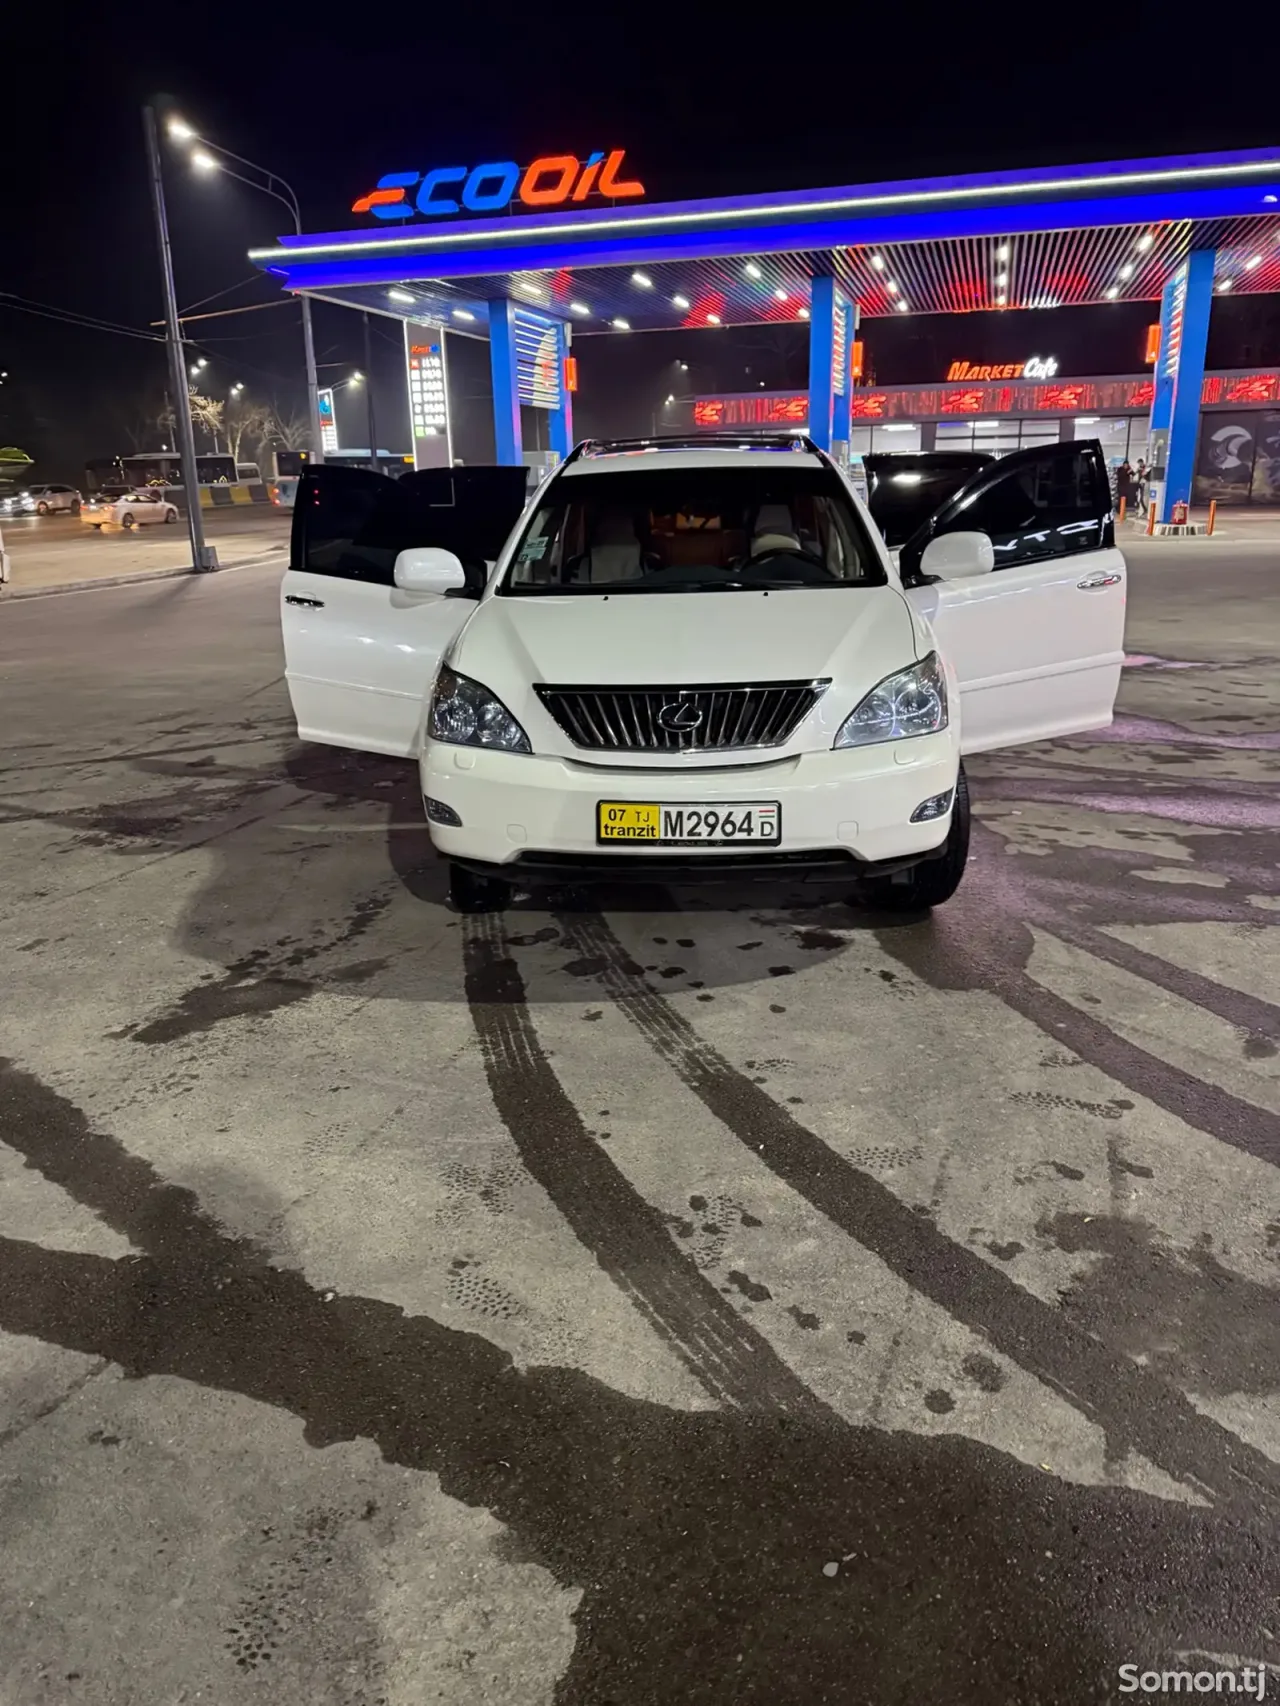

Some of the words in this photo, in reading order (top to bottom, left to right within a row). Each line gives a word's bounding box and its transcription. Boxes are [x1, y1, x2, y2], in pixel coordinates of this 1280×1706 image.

[608, 809, 626, 821] 07
[635, 811, 650, 822] TJ
[603, 823, 656, 837] tranzit
[663, 810, 754, 837] M2964
[760, 821, 775, 837] D
